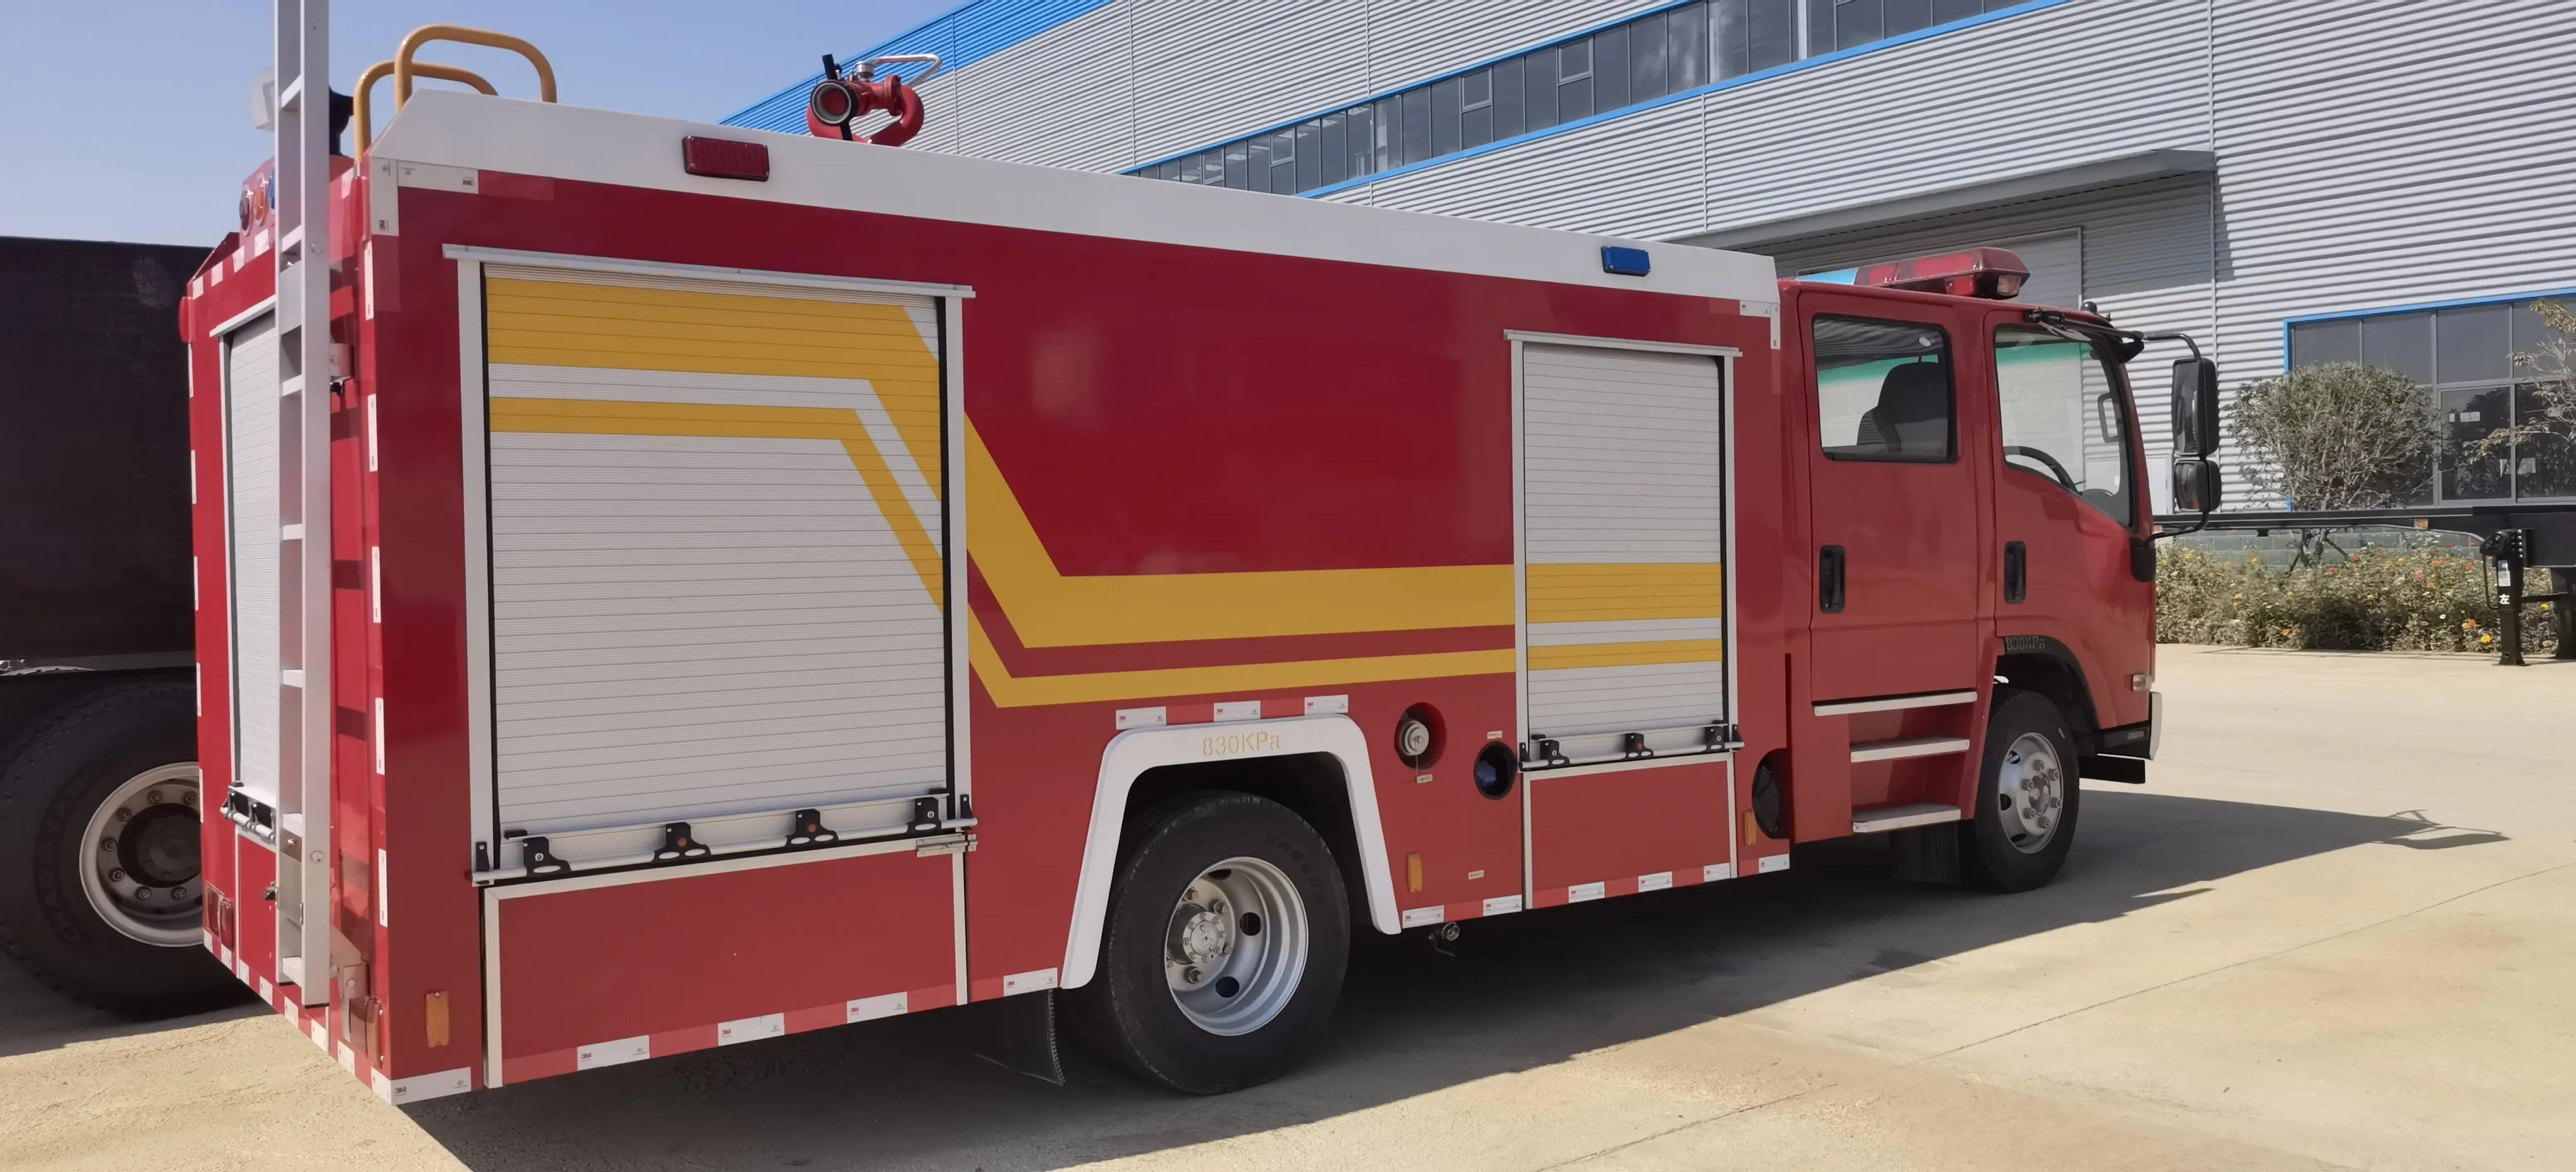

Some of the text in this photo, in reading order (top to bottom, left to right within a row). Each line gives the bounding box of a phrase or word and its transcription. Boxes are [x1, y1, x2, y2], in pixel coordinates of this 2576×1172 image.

[2499, 594, 2510, 604] 左
[1202, 731, 1281, 756] 830KPa
[394, 1086, 407, 1094] 3M
